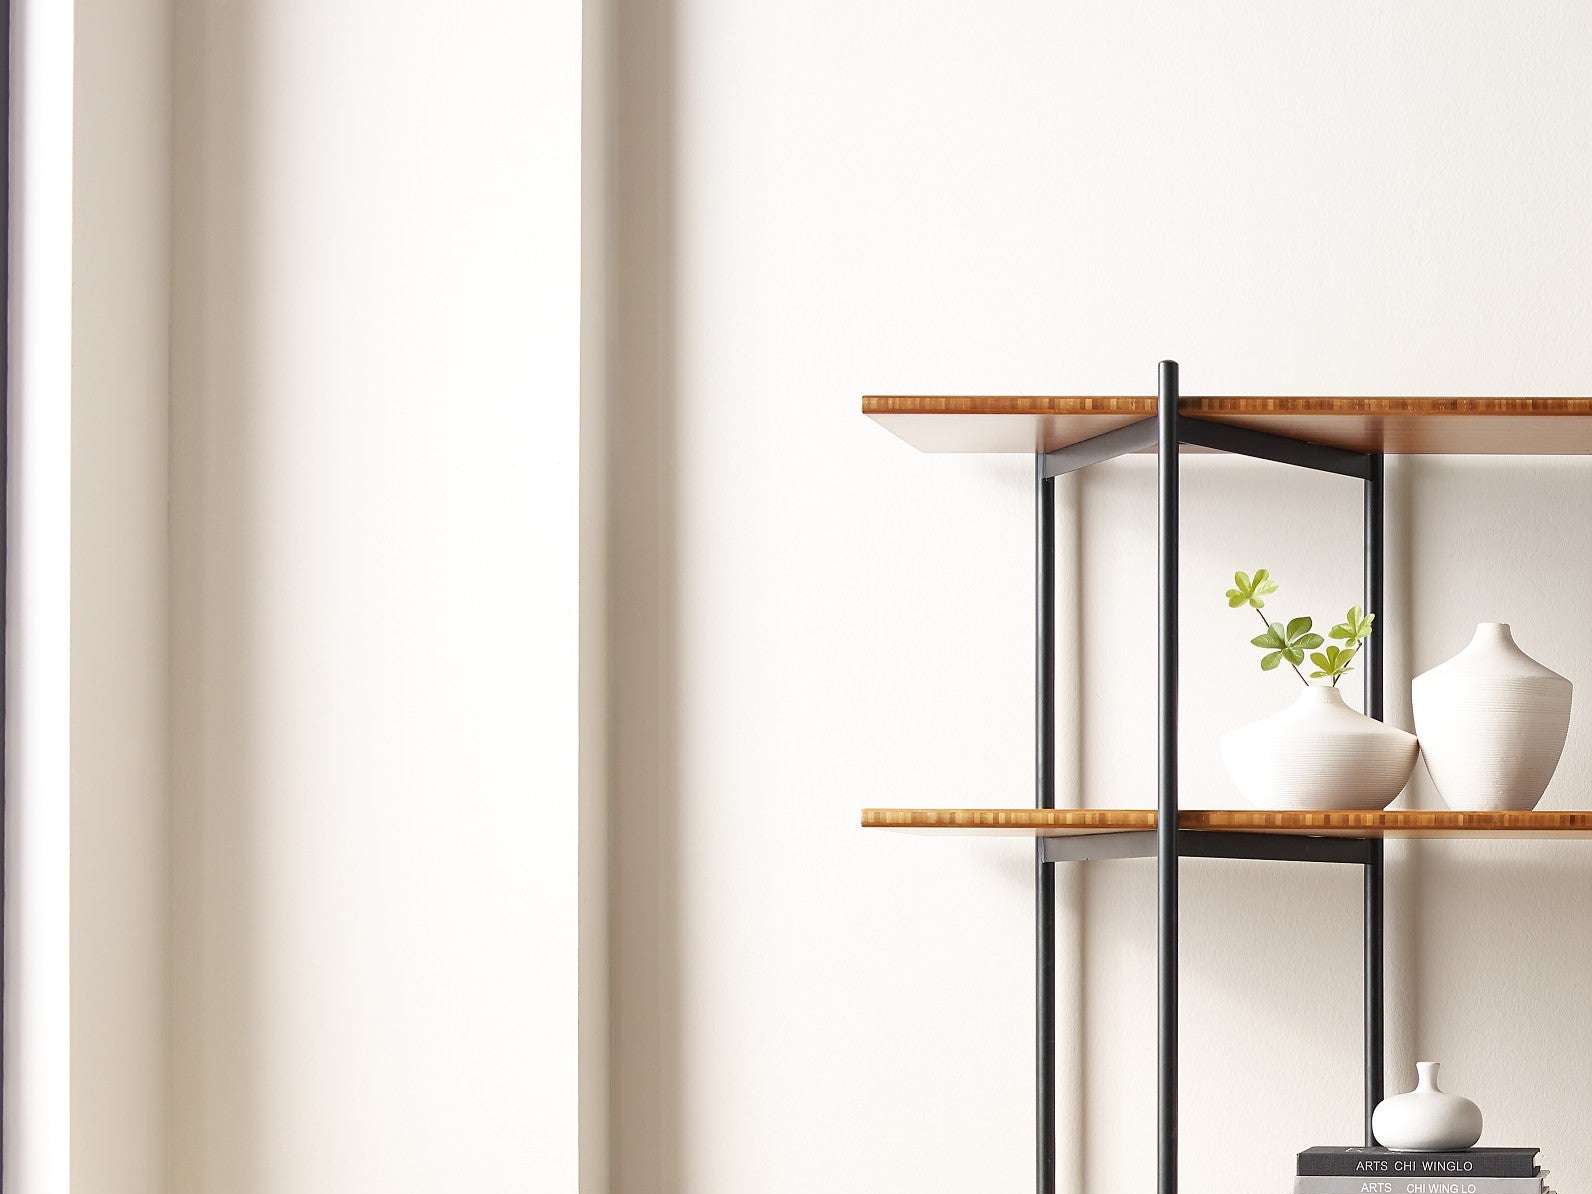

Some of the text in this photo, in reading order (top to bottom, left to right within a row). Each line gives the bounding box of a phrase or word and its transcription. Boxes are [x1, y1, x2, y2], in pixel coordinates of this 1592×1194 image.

[1355, 1160, 1473, 1172] ARTS CHI WINGLO
[1360, 1182, 1477, 1194] ARTS CHI WING LO
